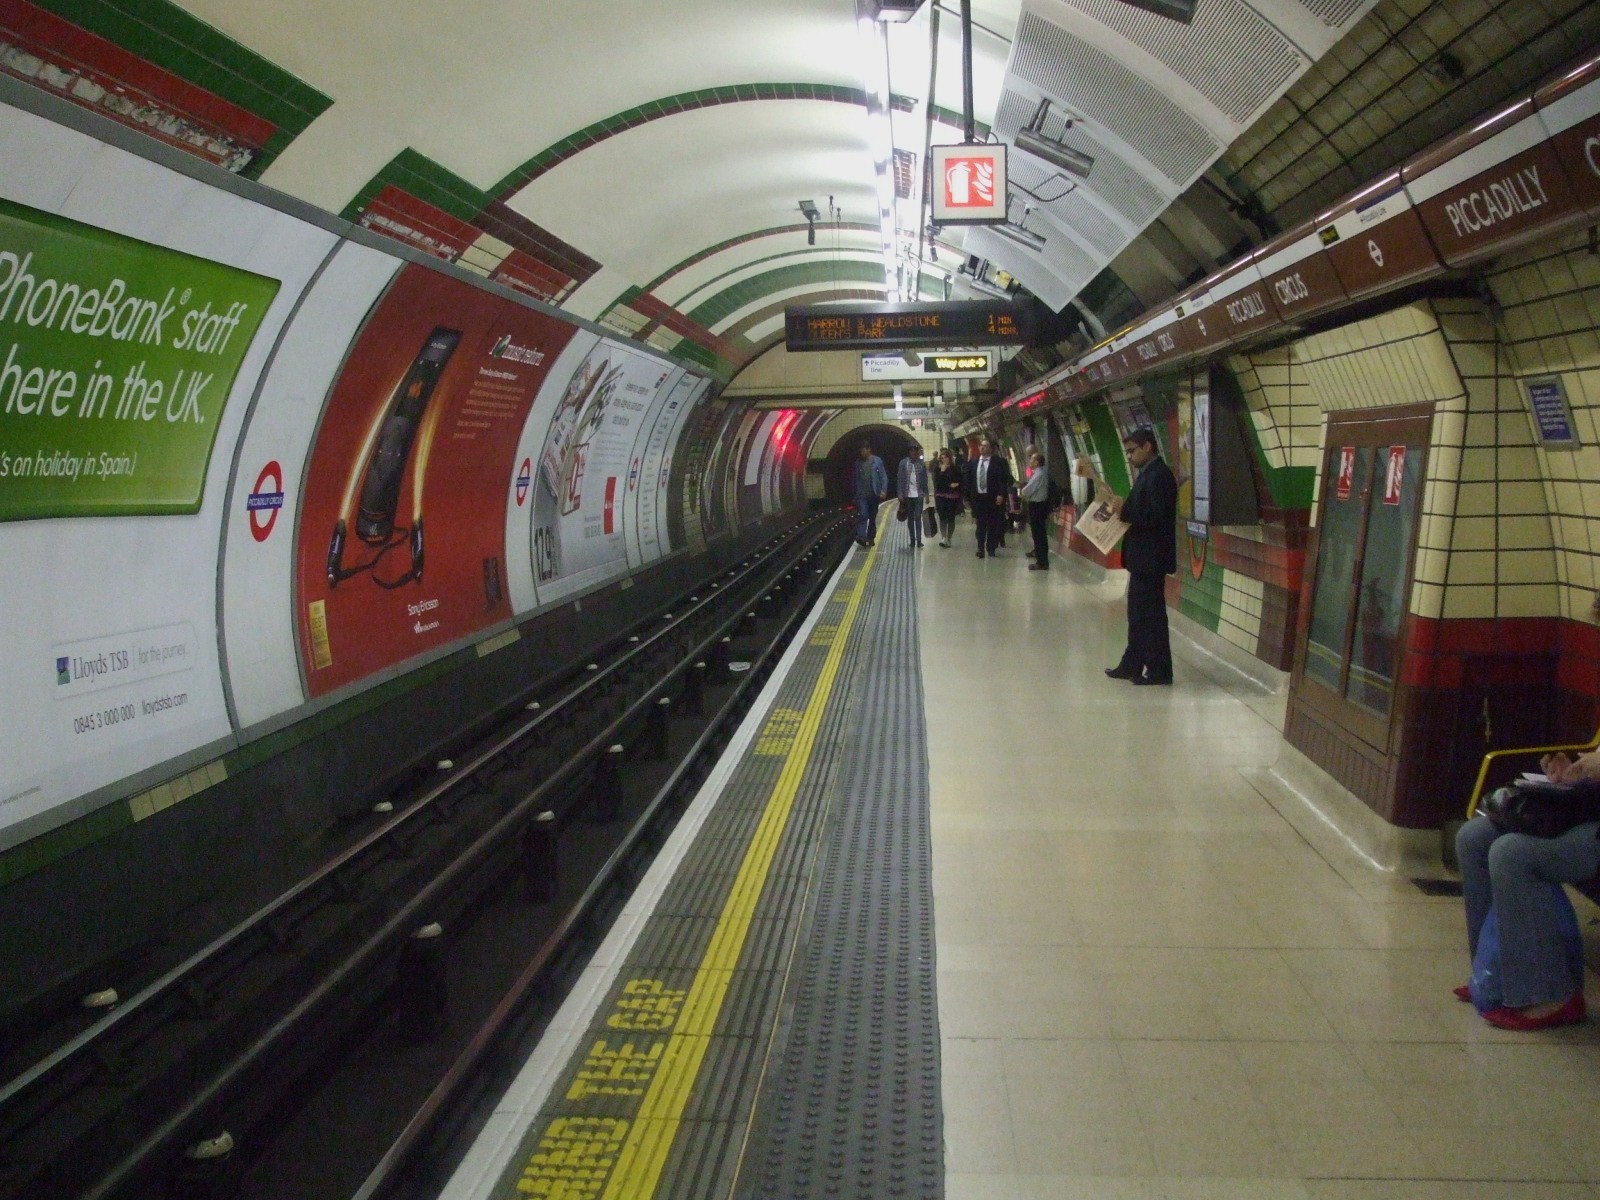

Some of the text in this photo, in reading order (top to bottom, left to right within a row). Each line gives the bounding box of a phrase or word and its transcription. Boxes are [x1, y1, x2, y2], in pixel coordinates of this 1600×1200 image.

[1445, 165, 1548, 236] PICCADILLY
[1226, 272, 1309, 325] PICCADILLY CIRCUS
[173, 301, 248, 356] staff
[857, 327, 886, 339] PARK
[988, 325, 995, 334] 4
[870, 359, 900, 369] Piccadilly
[870, 366, 882, 374] line
[935, 358, 976, 370] Way out
[0, 343, 214, 423] here in the UK.
[900, 409, 931, 419] Piccadilly
[12, 455, 32, 477] on
[34, 450, 83, 482] holiday
[84, 451, 98, 477] in
[406, 598, 440, 617] Sony Ericsson
[72, 650, 130, 684] Lloyds TSB
[73, 716, 96, 735] 0845
[96, 712, 103, 728] 3
[103, 706, 119, 726] 000
[119, 702, 136, 721] 000
[606, 979, 687, 1030] GAP
[565, 1040, 665, 1100] THE
